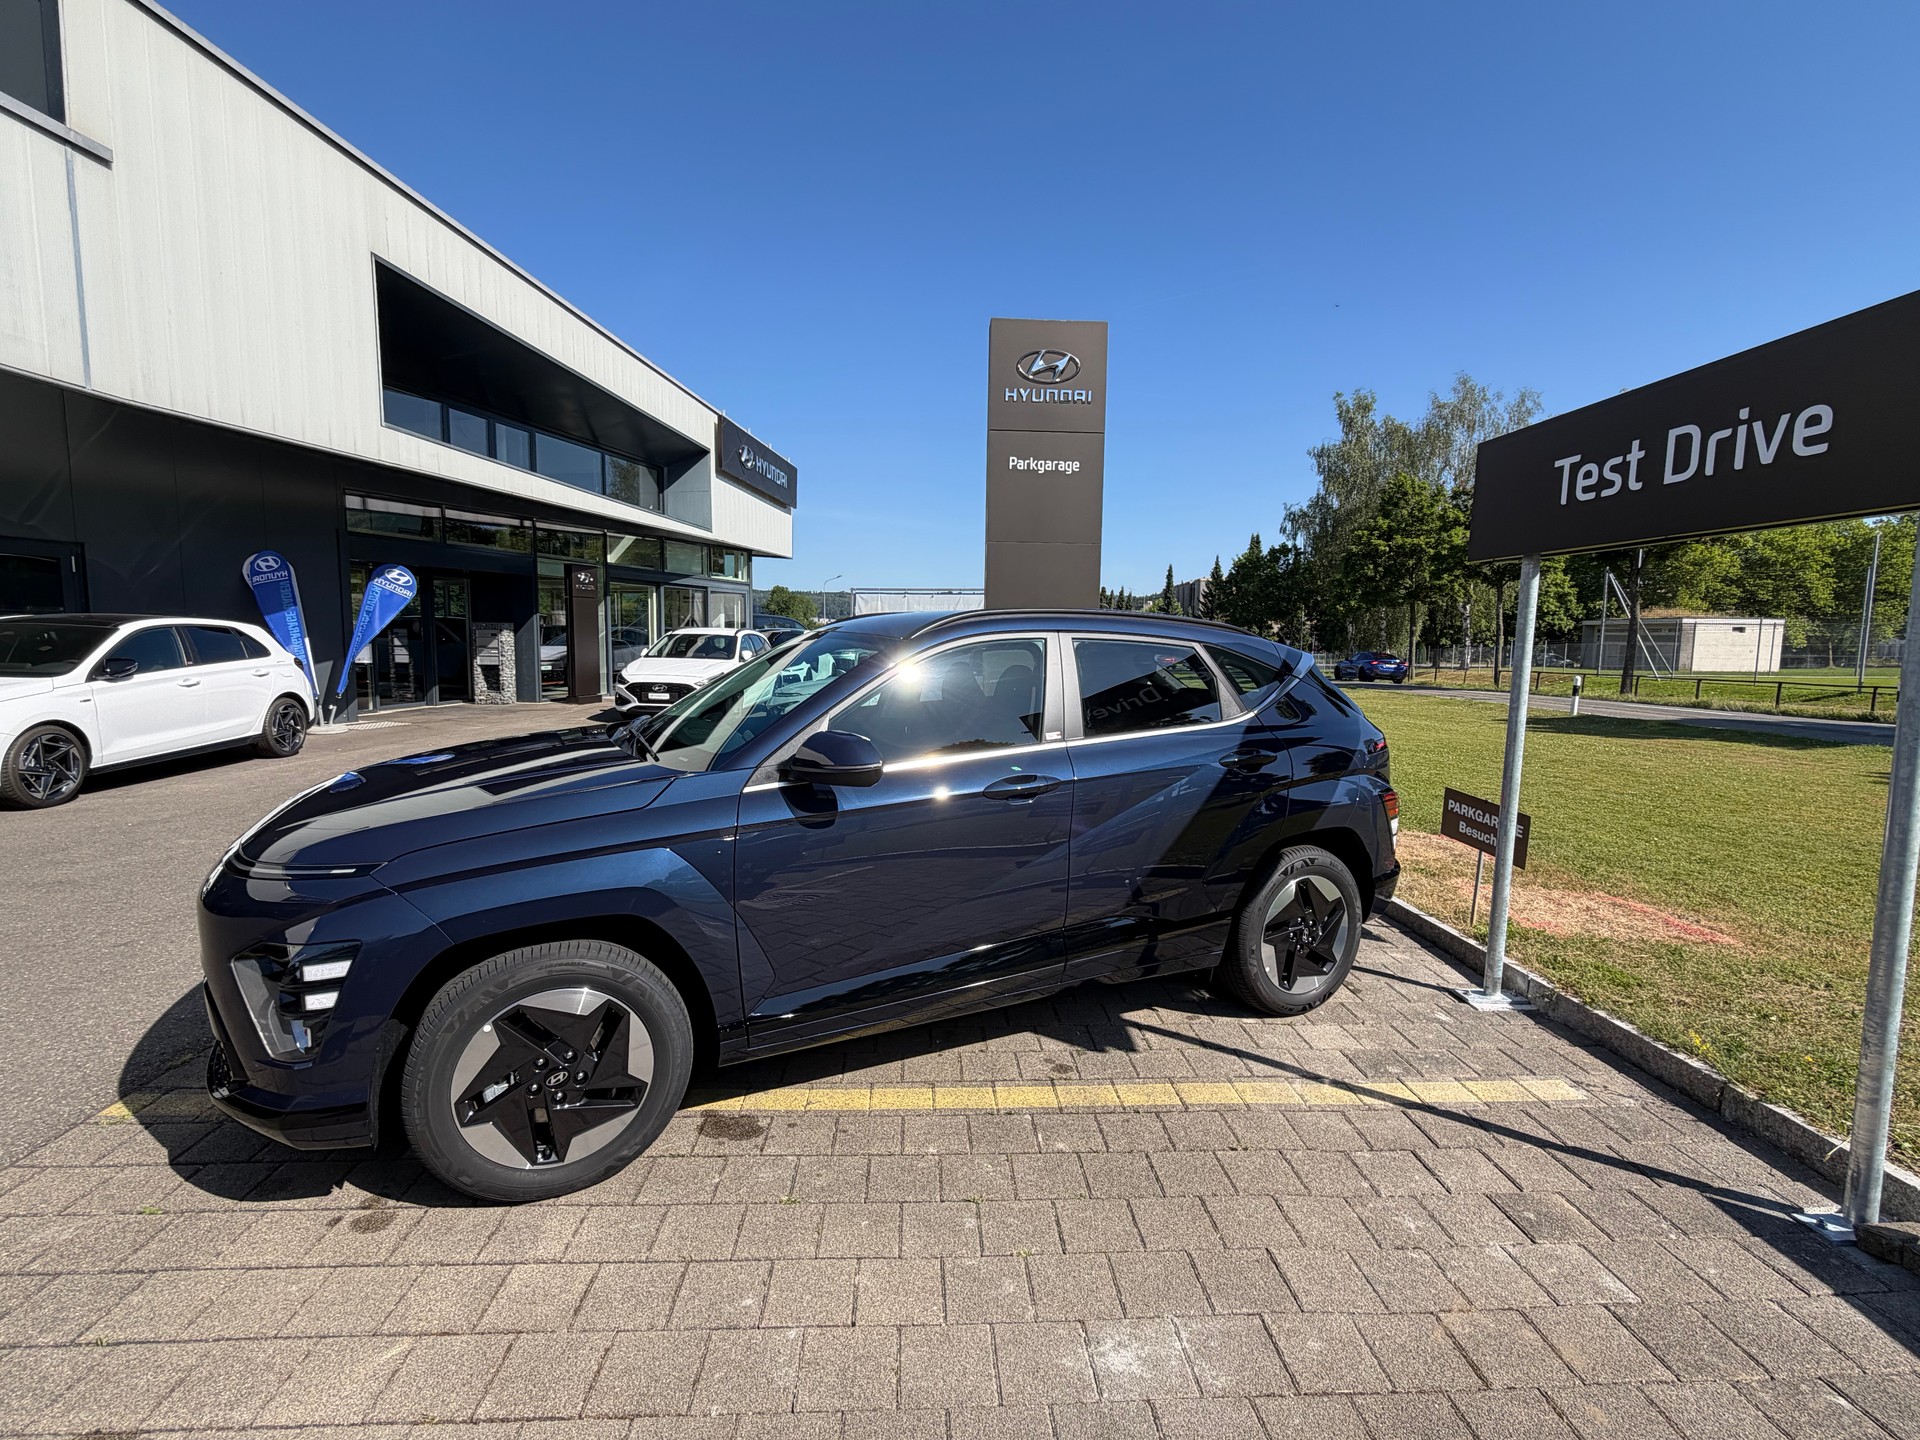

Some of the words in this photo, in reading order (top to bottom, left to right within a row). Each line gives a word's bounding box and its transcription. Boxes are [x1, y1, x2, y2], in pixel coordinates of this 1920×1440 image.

[1005, 388, 1092, 403] HYUNDAI
[1009, 457, 1080, 474] Parkgarage
[1554, 440, 1646, 505] Test
[1663, 404, 1833, 485] Drive
[755, 455, 788, 488] HYUNDAI
[368, 584, 382, 612] BADEN
[373, 577, 412, 597] HYUNDAI
[1448, 800, 1524, 838] PARKGARE
[1459, 821, 1496, 846] Besuch
